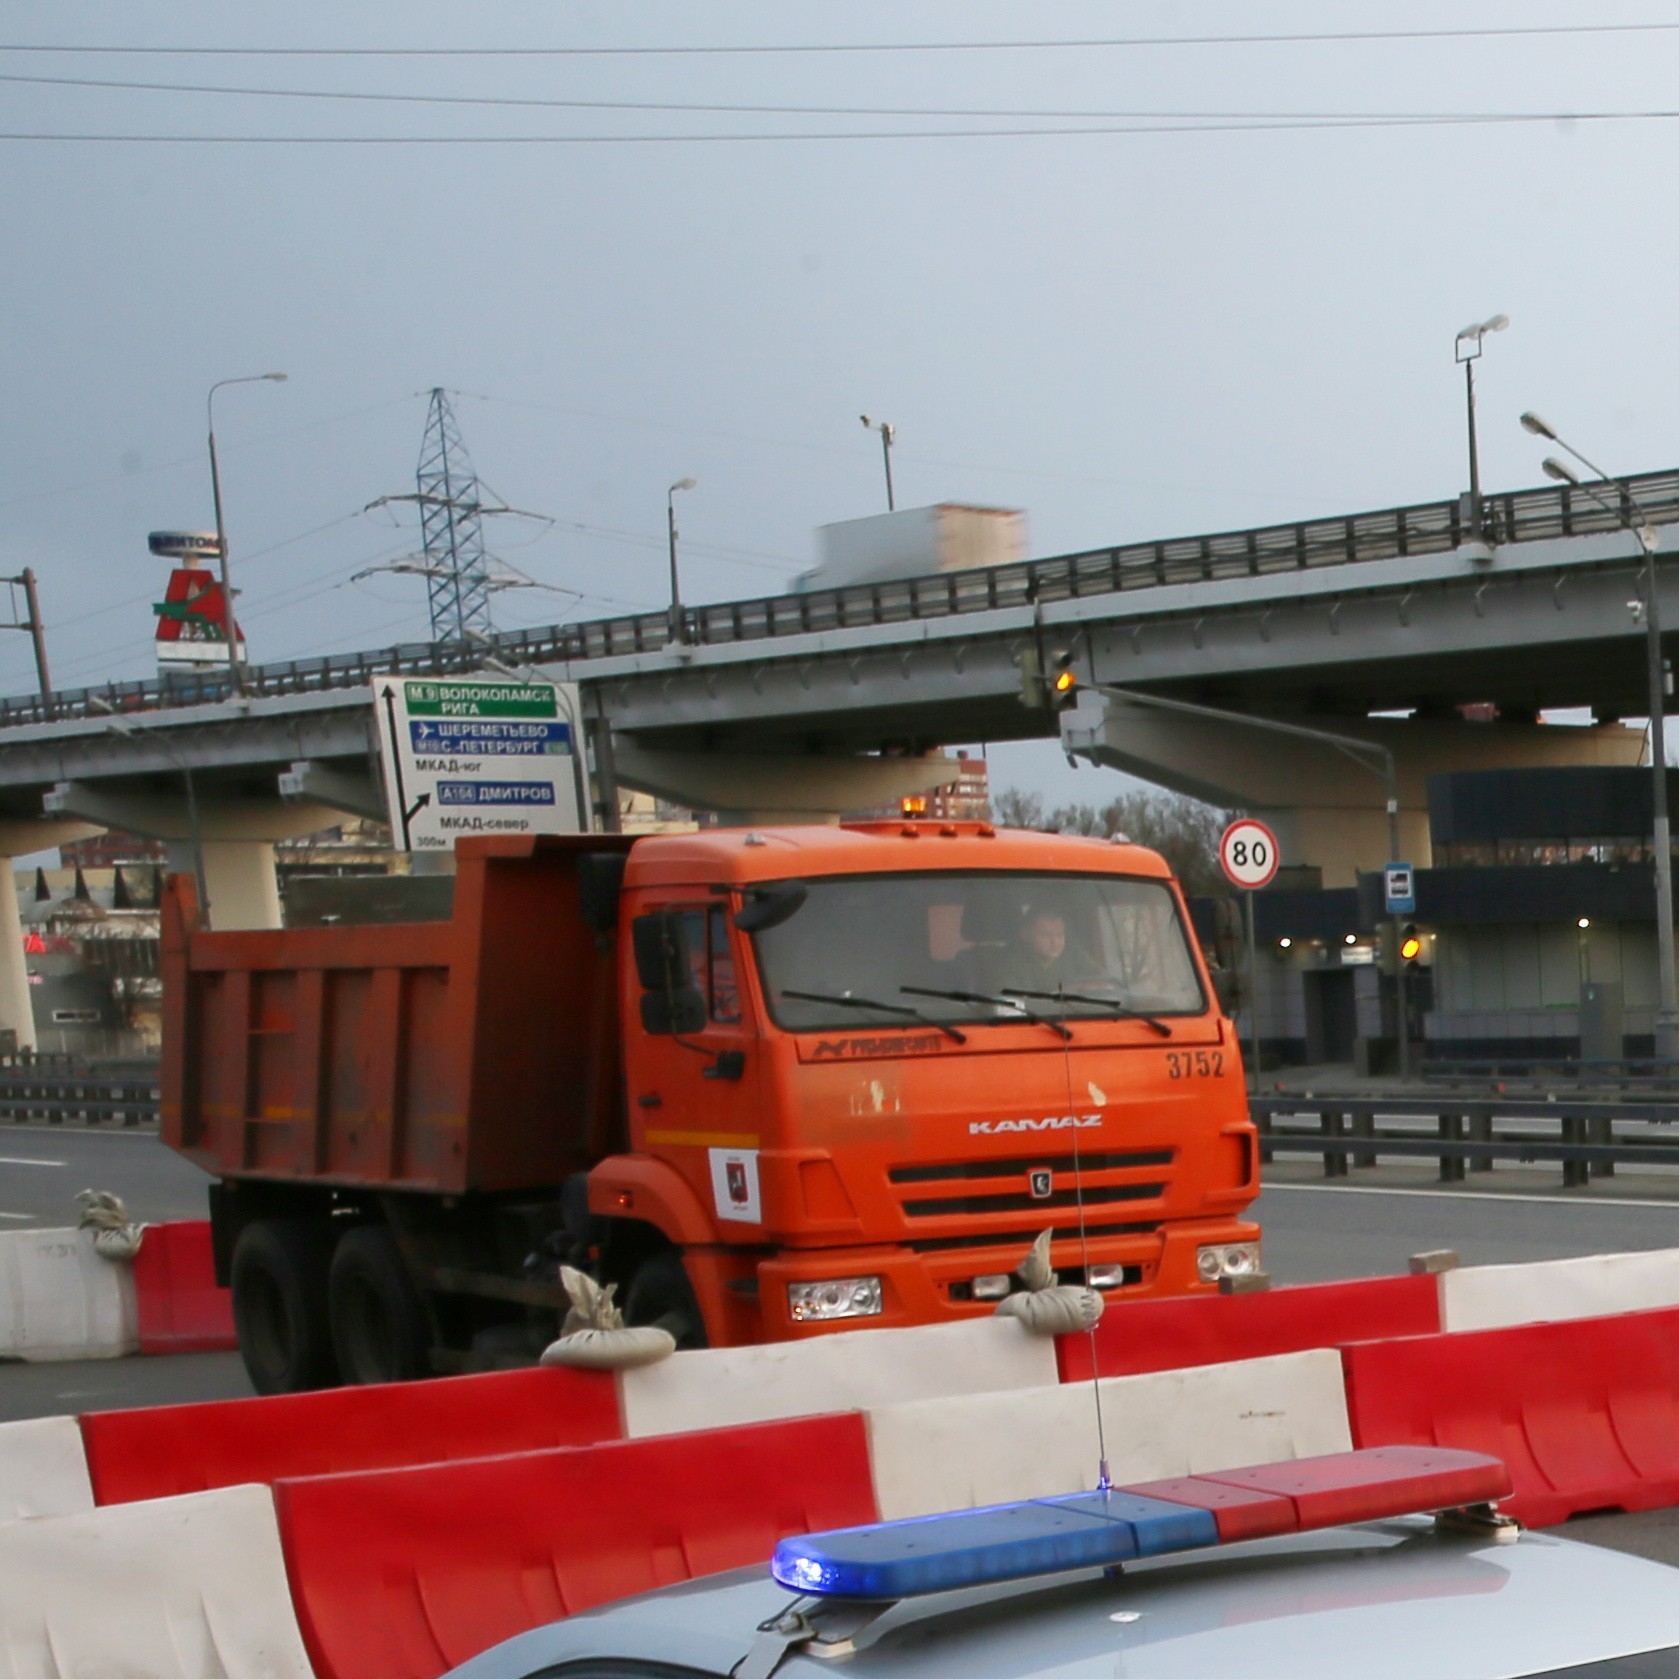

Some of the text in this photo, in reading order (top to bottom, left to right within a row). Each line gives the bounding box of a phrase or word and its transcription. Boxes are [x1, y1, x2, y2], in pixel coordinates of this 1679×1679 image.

[441, 703, 480, 715] РИГА
[438, 724, 549, 737] ШЕРЕМЕТЬЕВО
[415, 759, 482, 773] МКАД-юг
[479, 787, 551, 801] ДМИТРОВ
[440, 816, 529, 831] МКАД-север
[1233, 841, 1267, 866] 80
[1166, 1051, 1225, 1080] 3752
[969, 1114, 1102, 1135] KAMAZ
